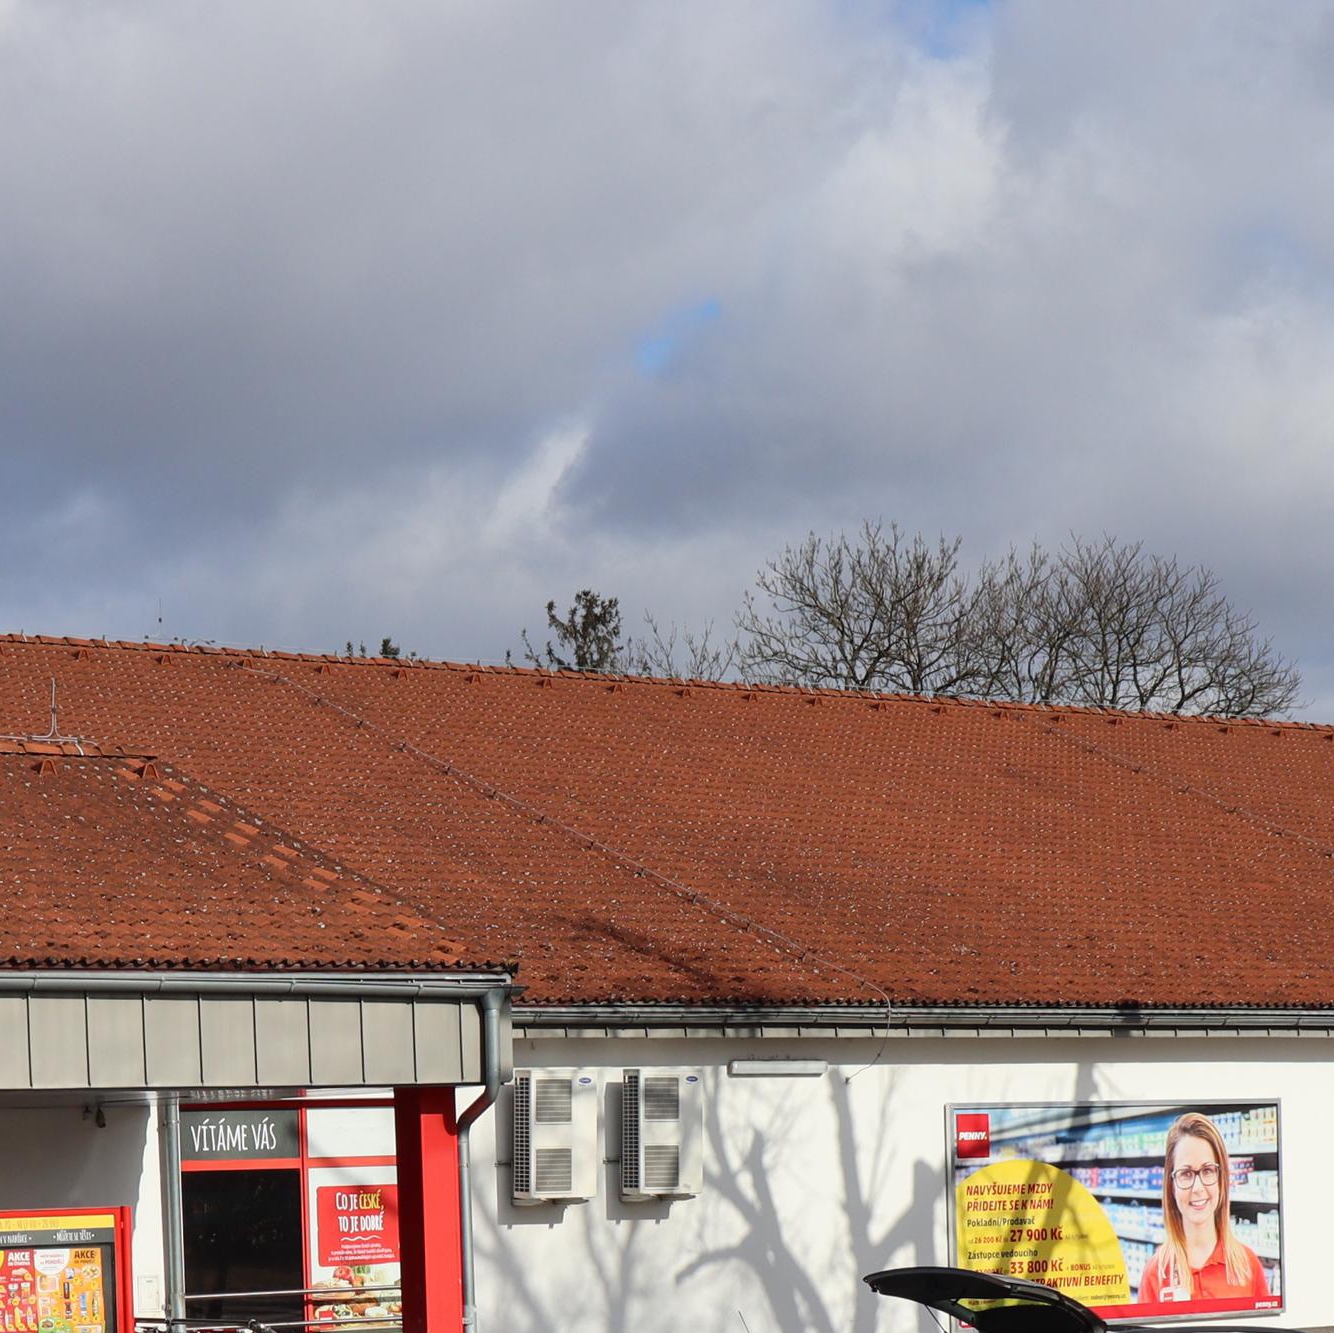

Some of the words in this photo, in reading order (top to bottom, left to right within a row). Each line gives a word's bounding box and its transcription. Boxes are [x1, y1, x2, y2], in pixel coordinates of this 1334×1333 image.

[190, 1118, 248, 1152] VÍTÁME
[251, 1117, 276, 1150] VÁS
[966, 1182, 1026, 1196] NAVYŠUJEME
[1027, 1183, 1053, 1195] MZDY
[349, 1194, 358, 1211] JE
[966, 1198, 1007, 1212] PŘIDEJTE
[1009, 1199, 1020, 1210] SE
[1021, 1199, 1028, 1210] K
[1029, 1195, 1054, 1209] NÁM!
[338, 1216, 348, 1232] TO
[350, 1216, 359, 1233] JE
[360, 1211, 384, 1231] DOBRÉ
[967, 1216, 1035, 1228] Pokladní/Prodavač
[1010, 1229, 1024, 1242] 27
[1027, 1229, 1047, 1241] 900
[1051, 1226, 1063, 1240] Kč
[8, 1252, 30, 1260] AKCE
[74, 1250, 95, 1259] AKCE
[968, 1248, 1000, 1260] Zástupce
[1001, 1248, 1038, 1258] vedoucího
[1010, 1261, 1024, 1273] 33
[1027, 1260, 1048, 1273] 800
[1051, 1257, 1063, 1272] Kč
[1070, 1263, 1091, 1271] BONUS
[1031, 1272, 1082, 1288] RAKTIVNÍ
[1084, 1274, 1124, 1287] BENEFITY
